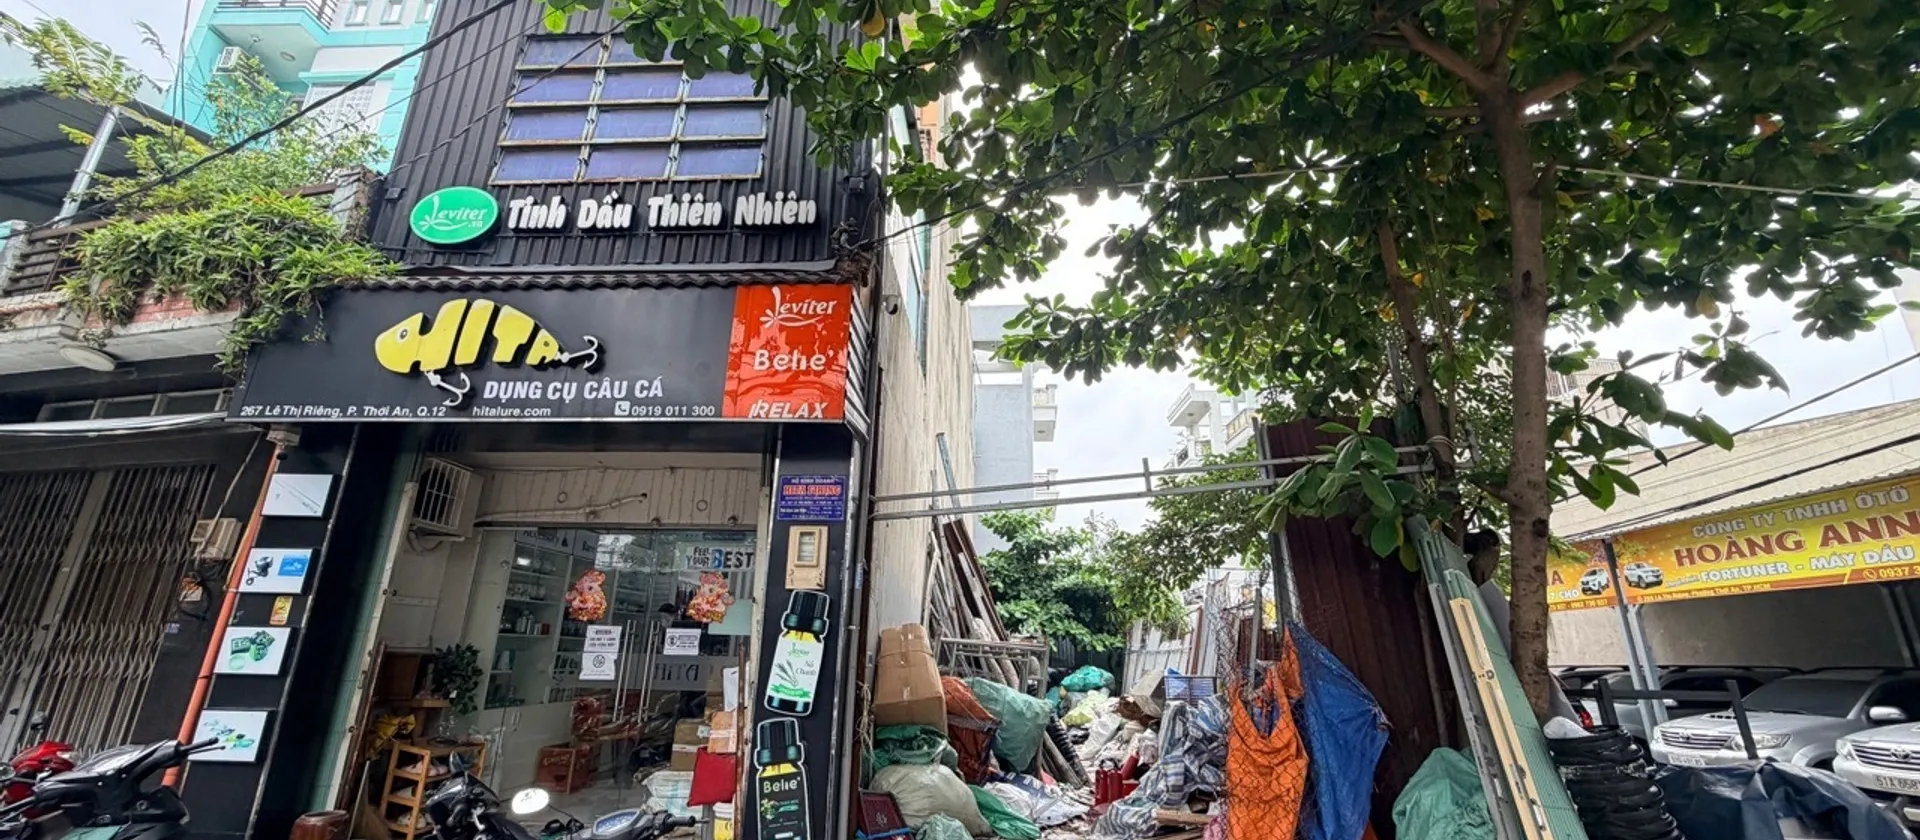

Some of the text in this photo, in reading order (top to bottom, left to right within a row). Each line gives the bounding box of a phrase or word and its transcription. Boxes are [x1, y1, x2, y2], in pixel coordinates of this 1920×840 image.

[508, 195, 567, 229] Tinh
[648, 192, 722, 227] Thiên
[734, 191, 816, 226] Nhiên
[770, 286, 837, 317] Leviter
[374, 298, 560, 373] HITA
[483, 375, 664, 404] DỤNG CỤ CÂU CÁ
[240, 405, 447, 418] 267 Lê Thị Riêng, P. Thới An, Q.12
[472, 406, 552, 417] hitalure.com
[631, 405, 715, 416] 0919 011 300
[1750, 513, 1777, 528] TY
[1783, 500, 1849, 522] TNHH
[712, 549, 755, 568] BEST
[1673, 530, 1807, 567] HOÀNG
[1700, 561, 1791, 583] FORTUNER
[1810, 551, 1857, 571] MÁY
[1879, 566, 1910, 578] 0937
